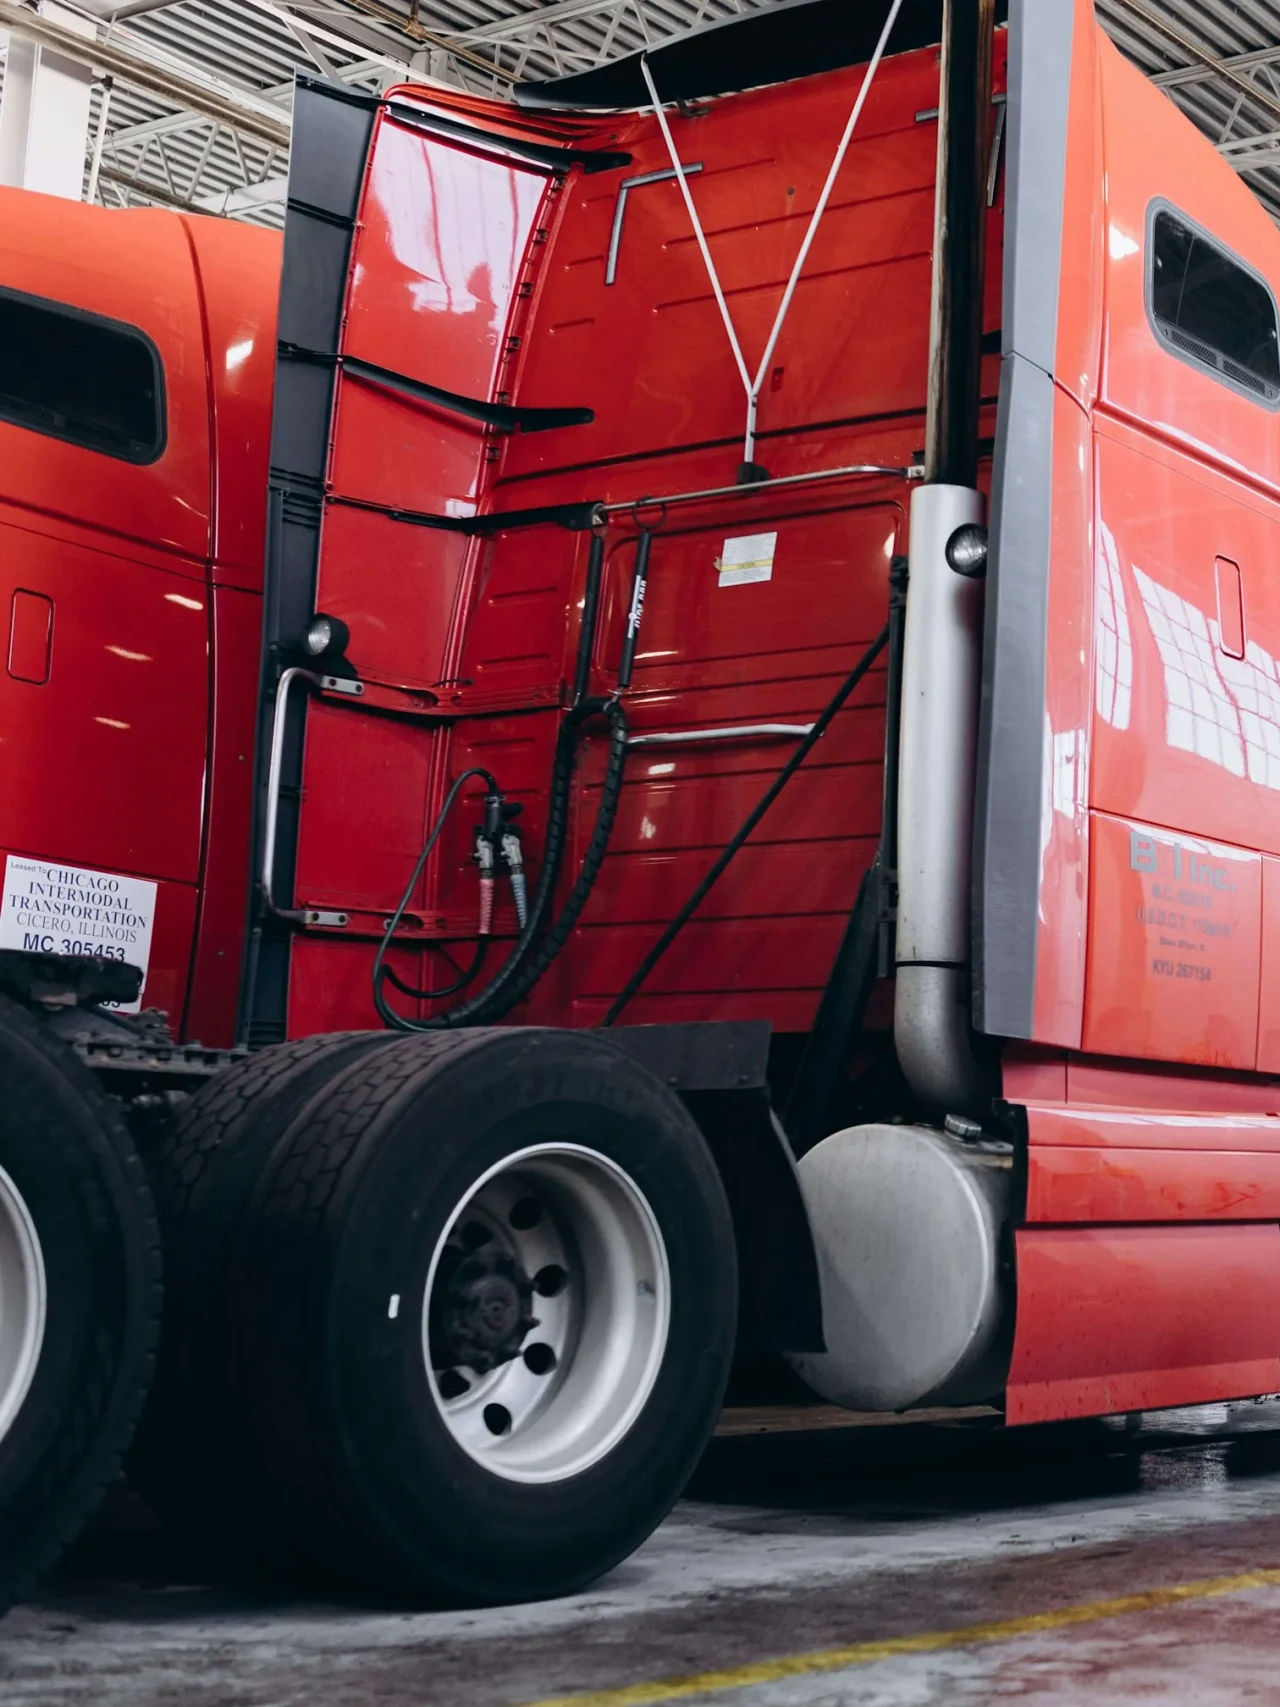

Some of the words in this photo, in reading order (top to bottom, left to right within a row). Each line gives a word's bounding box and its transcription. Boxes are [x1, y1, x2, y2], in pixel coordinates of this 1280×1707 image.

[11, 861, 36, 873] Leased
[38, 866, 47, 874] To
[46, 868, 119, 893] CHICAGO
[1190, 855, 1236, 893] Inc.
[9, 894, 148, 929] TRANSPORTATION
[29, 881, 132, 911] INTERMODAL
[16, 911, 74, 935] CICERO,
[78, 921, 137, 943] ILLINOIS
[23, 932, 54, 953] MC
[61, 938, 125, 963] 305453
